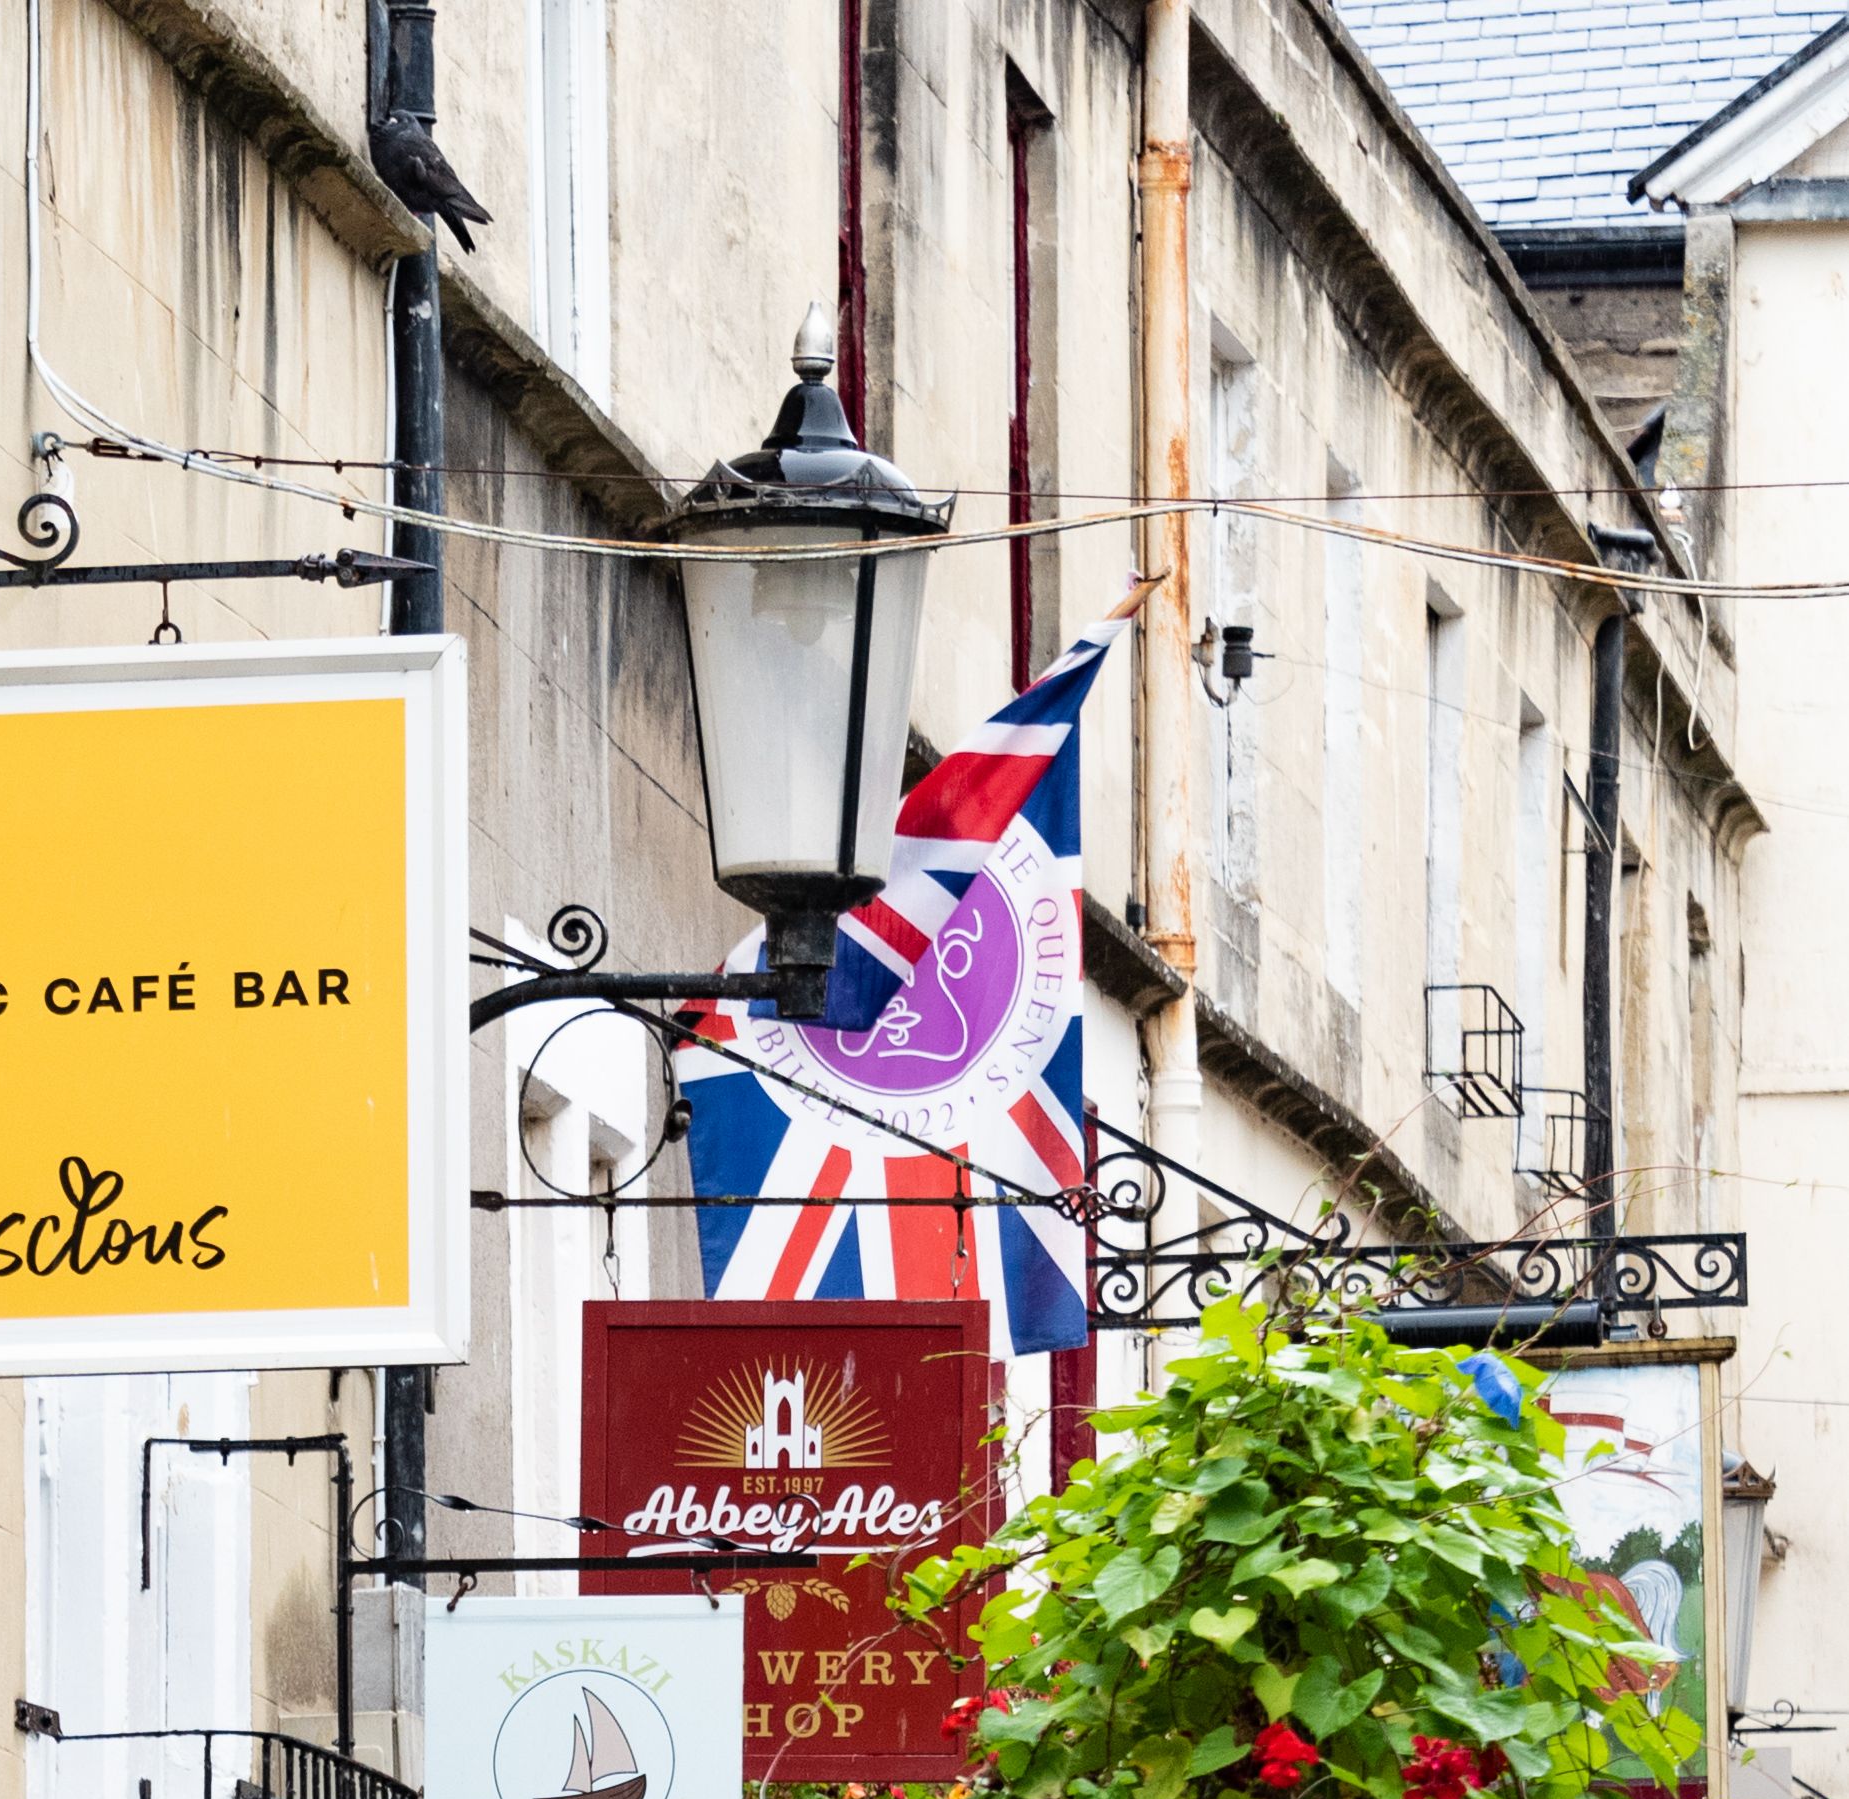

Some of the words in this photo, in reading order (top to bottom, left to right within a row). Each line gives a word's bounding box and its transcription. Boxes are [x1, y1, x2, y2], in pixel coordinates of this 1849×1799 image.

[998, 828, 1040, 884] HE
[43, 961, 198, 1014] CAFÉ
[233, 967, 352, 1010] BAR
[986, 897, 1065, 1092] QUEEN'S
[755, 1025, 853, 1128] BILEE
[866, 1102, 956, 1139] 2022
[742, 1475, 825, 1495] EST.1997
[624, 1485, 806, 1551] Abbey
[807, 1484, 945, 1537] Ales
[497, 1637, 674, 1698] KASKAZI
[757, 1651, 940, 1686] WERY
[742, 1703, 865, 1738] HOP
